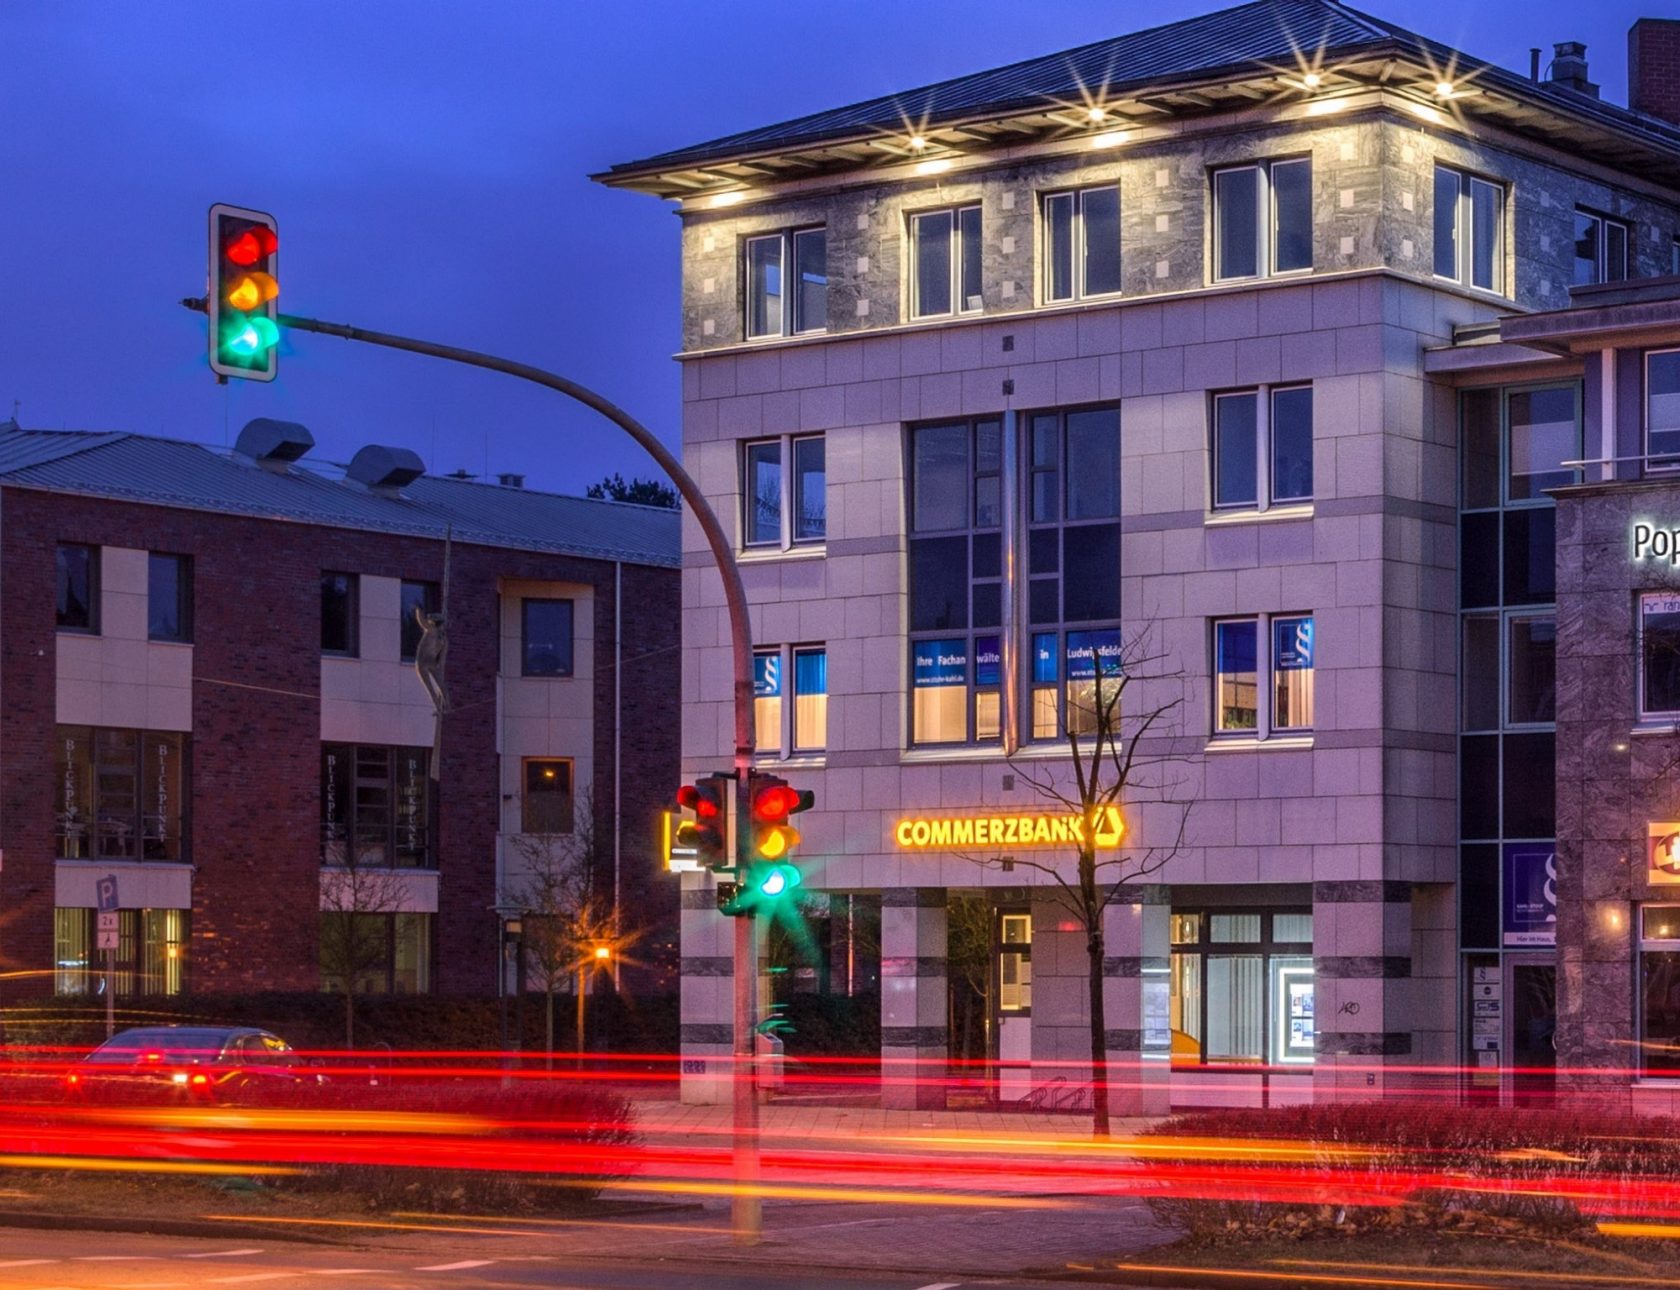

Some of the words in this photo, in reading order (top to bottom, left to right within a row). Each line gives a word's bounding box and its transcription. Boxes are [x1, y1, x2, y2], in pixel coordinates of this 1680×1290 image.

[917, 656, 933, 666] Ihre
[1039, 649, 1050, 660] in
[327, 754, 336, 847] BLICKPUNK
[897, 816, 1085, 846] COMMERZBANK
